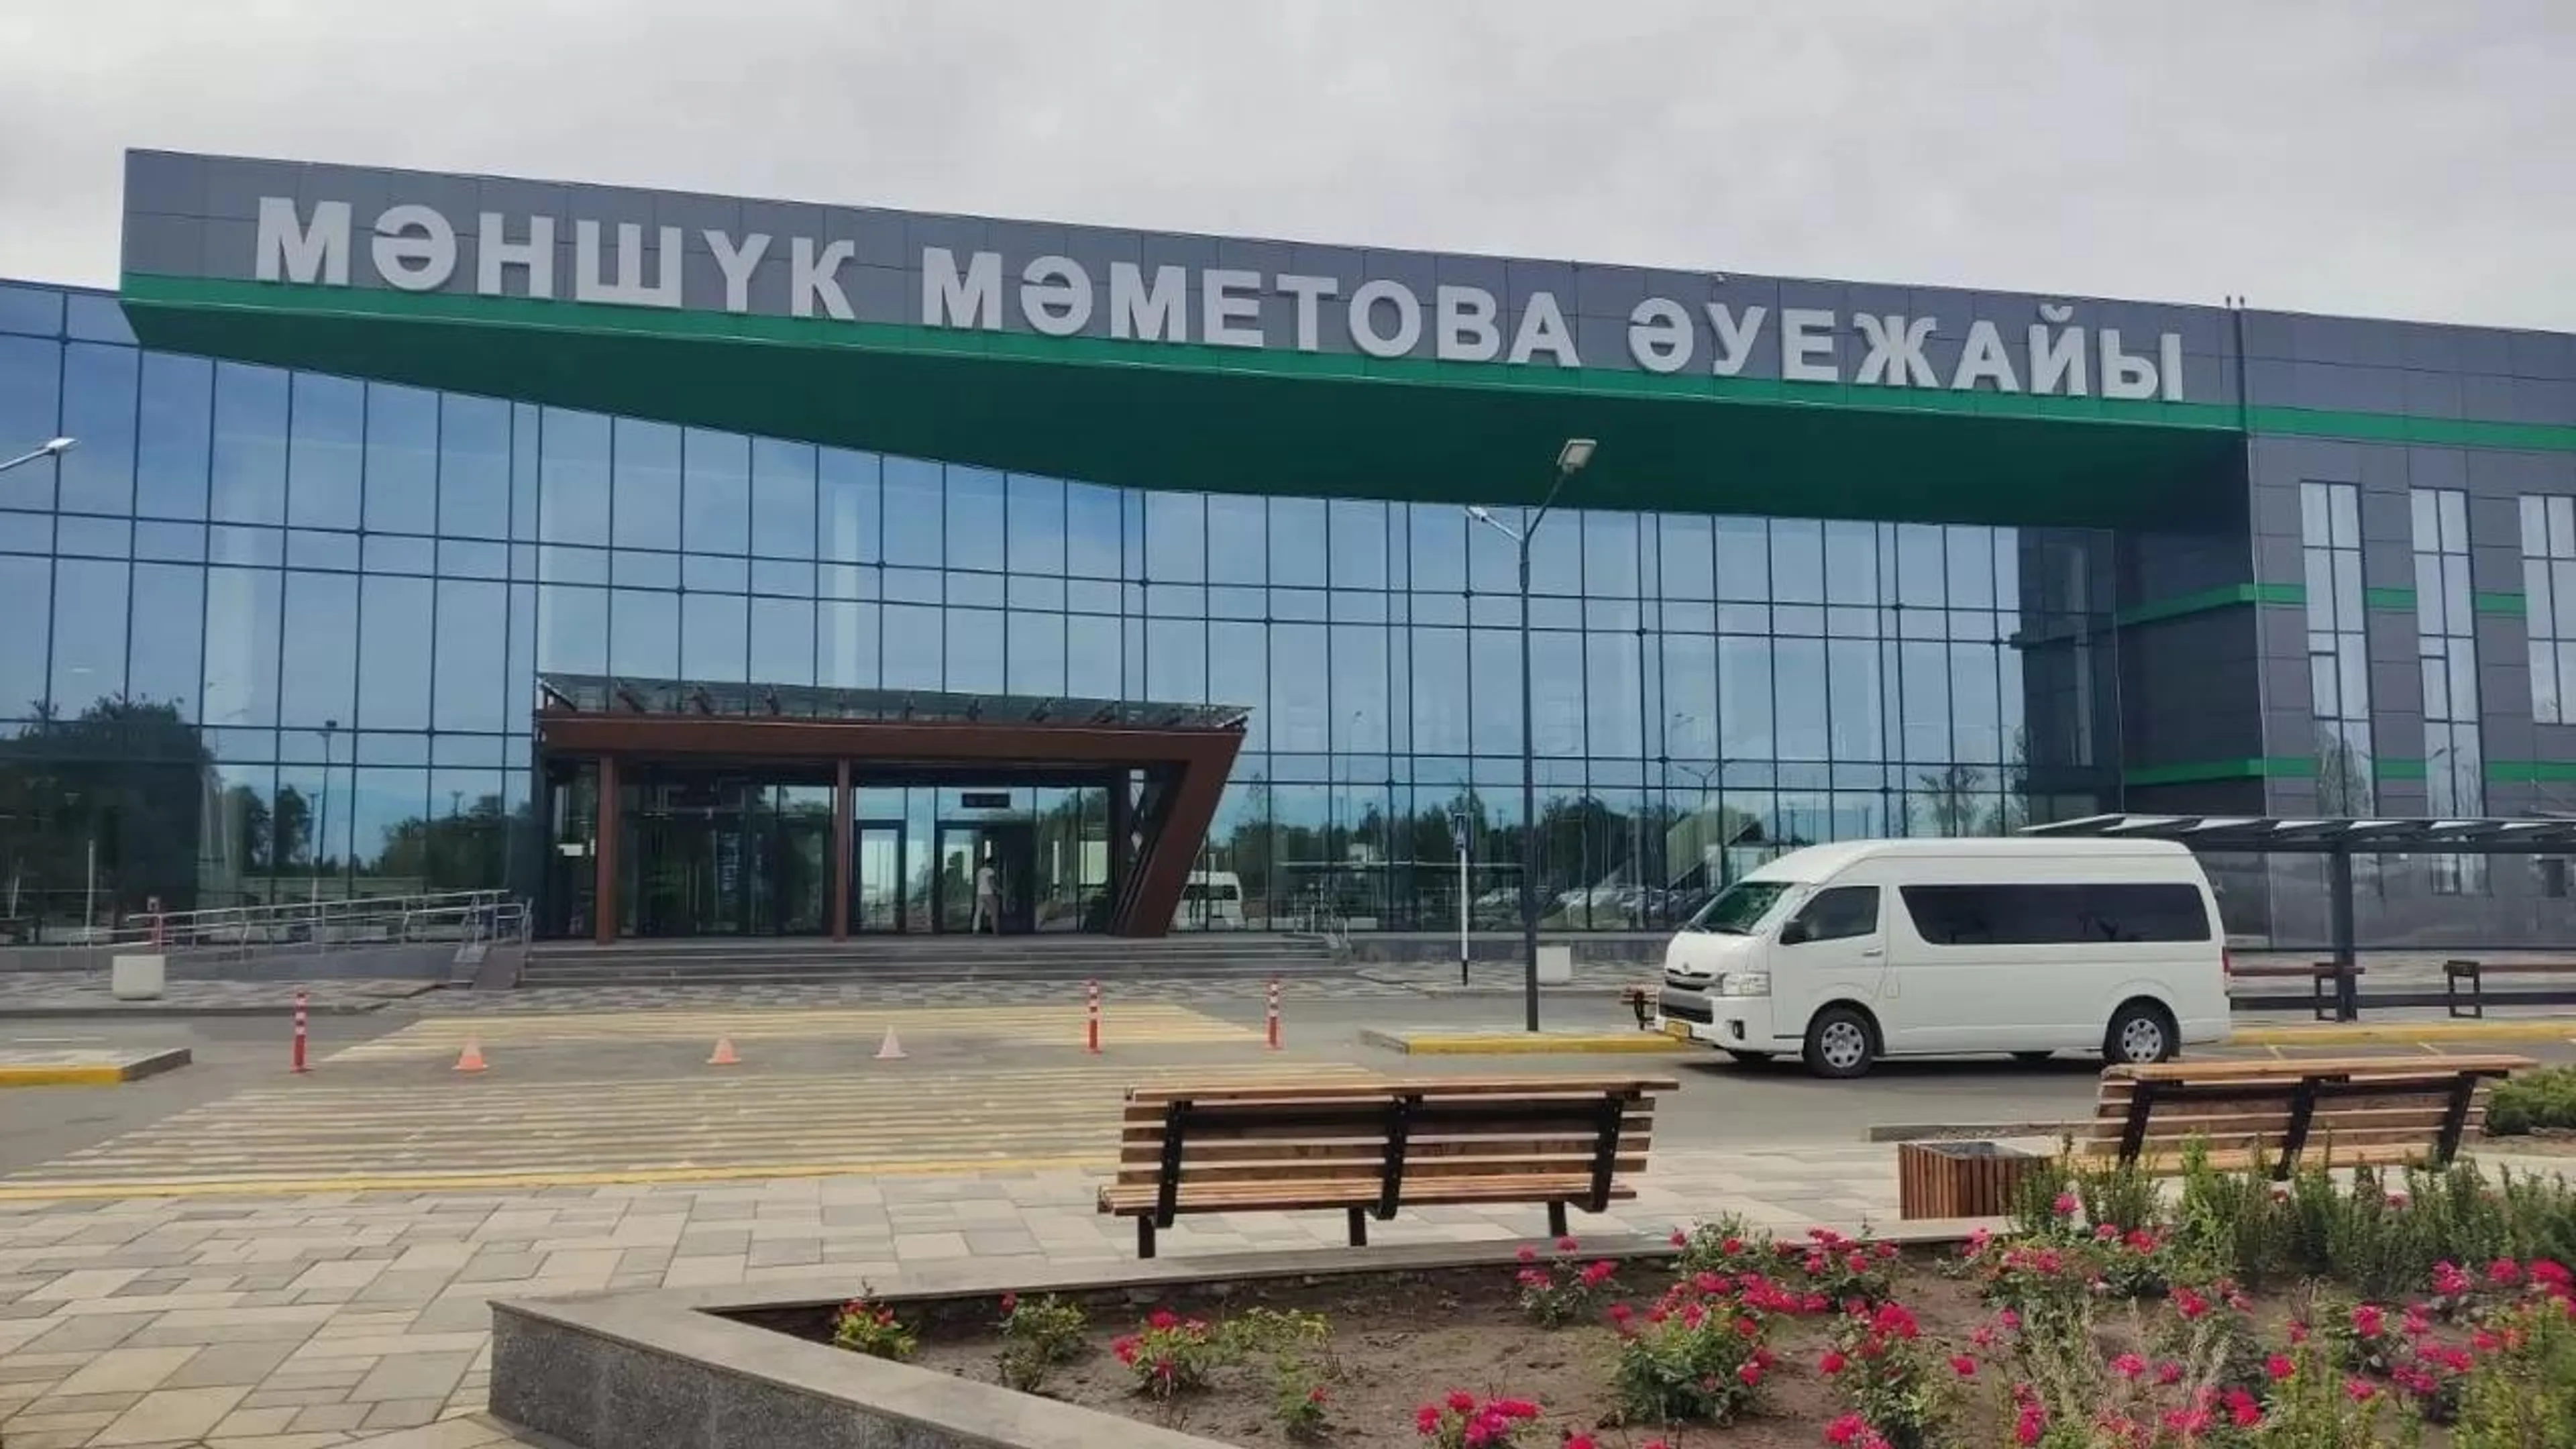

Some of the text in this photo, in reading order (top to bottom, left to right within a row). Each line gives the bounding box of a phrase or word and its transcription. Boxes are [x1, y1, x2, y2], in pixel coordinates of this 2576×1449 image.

[255, 197, 2184, 401] МӘНШҮК МӘМЕТОВА ӘУЕЖАЙЫ
